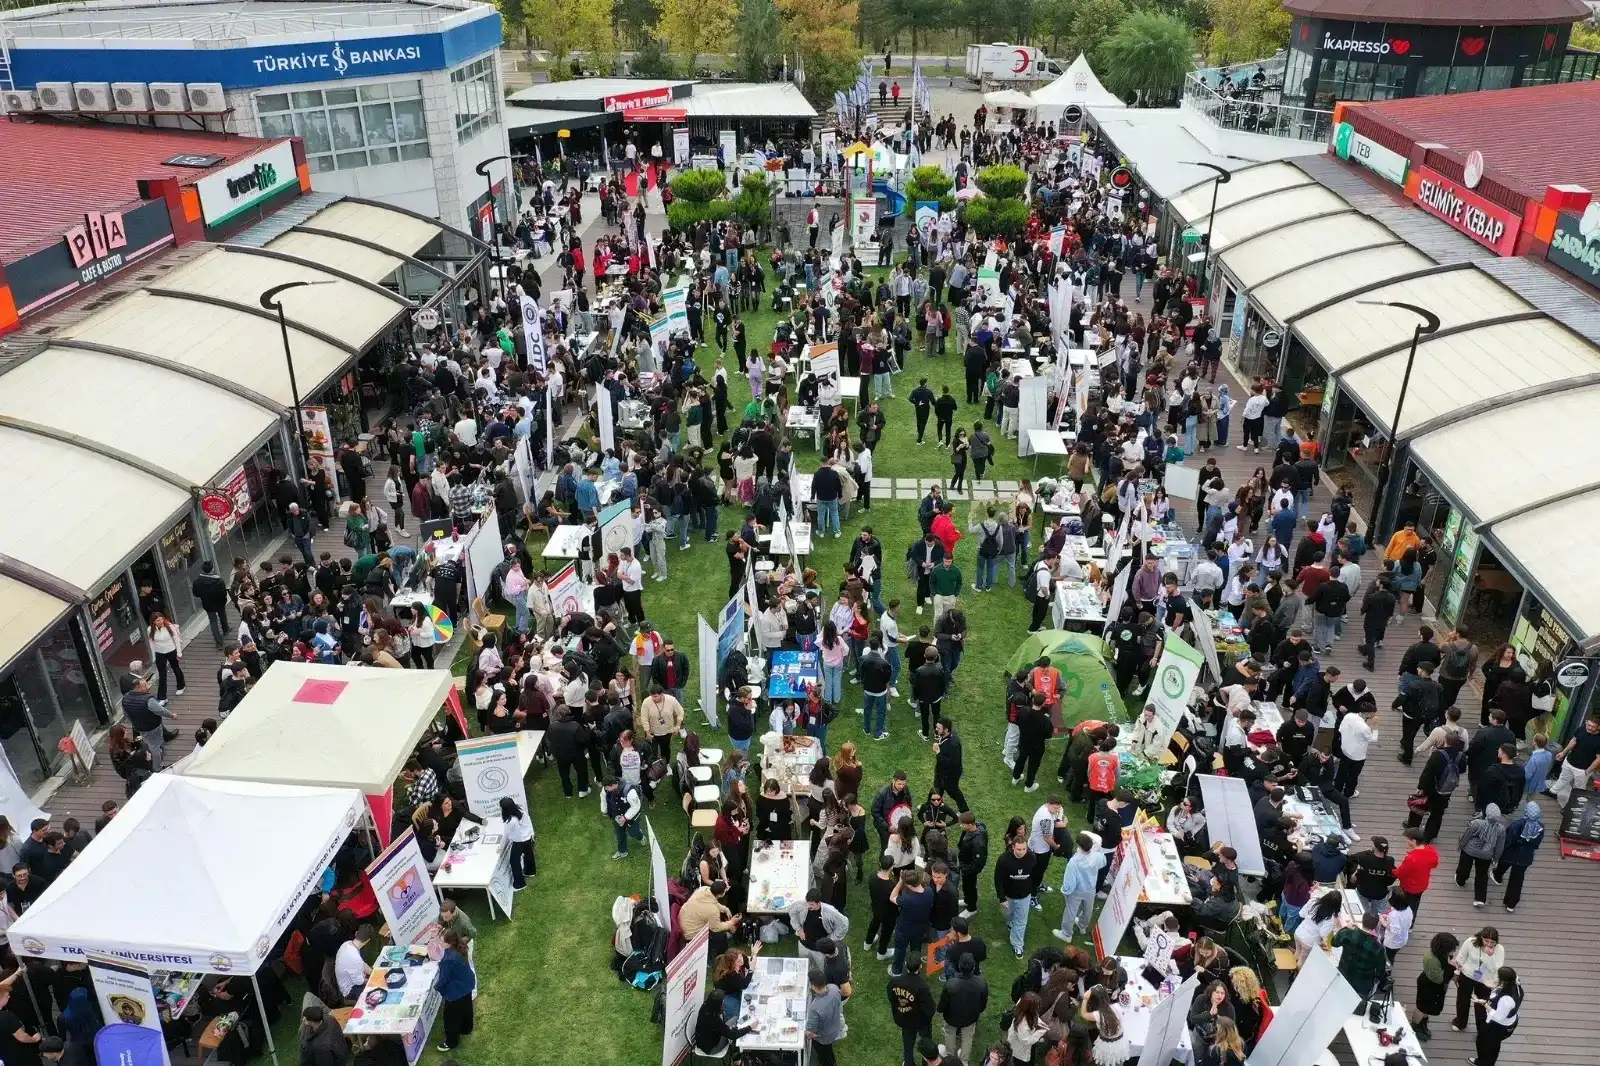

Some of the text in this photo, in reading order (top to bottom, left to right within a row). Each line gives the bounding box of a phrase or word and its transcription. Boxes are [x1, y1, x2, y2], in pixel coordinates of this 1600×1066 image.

[253, 52, 330, 73] TÜRKİYE
[350, 46, 421, 65] BANKASI
[1356, 141, 1371, 159] TEB
[1418, 179, 1503, 245] SELİMİYE KEBAP
[81, 265, 98, 282] CAFE
[892, 987, 915, 1002] TOKYO
